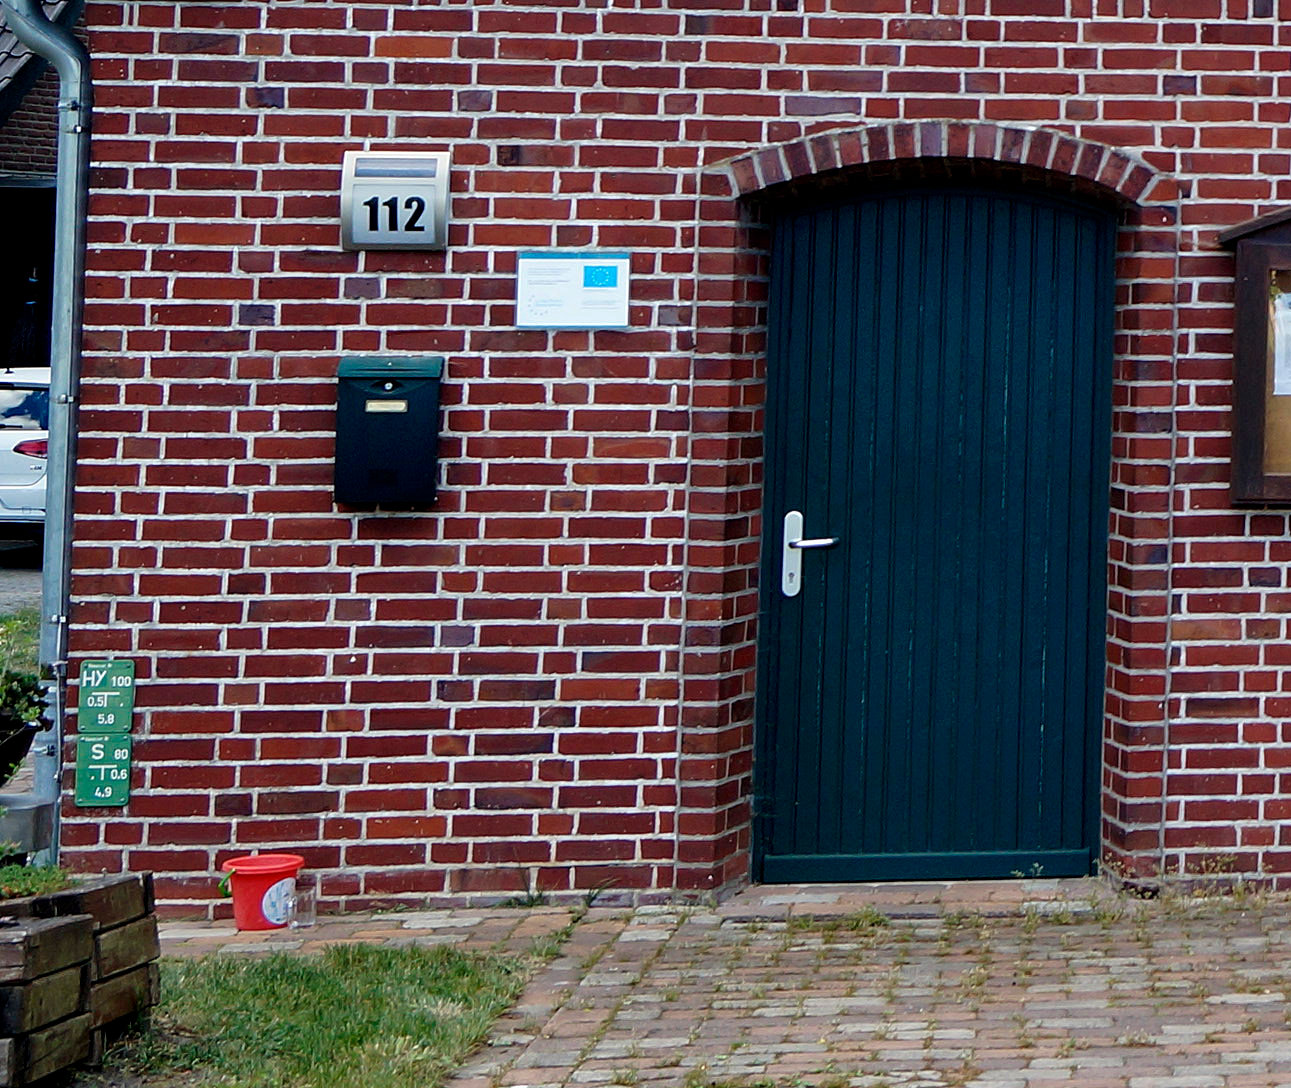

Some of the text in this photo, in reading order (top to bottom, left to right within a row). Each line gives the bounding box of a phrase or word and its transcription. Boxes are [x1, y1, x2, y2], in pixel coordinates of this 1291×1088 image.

[362, 196, 426, 232] 112
[82, 670, 132, 687] HY 100
[97, 713, 115, 724] 5.8
[91, 743, 129, 760] S 80
[110, 769, 128, 780] 0.6
[94, 786, 113, 798] 4.9
